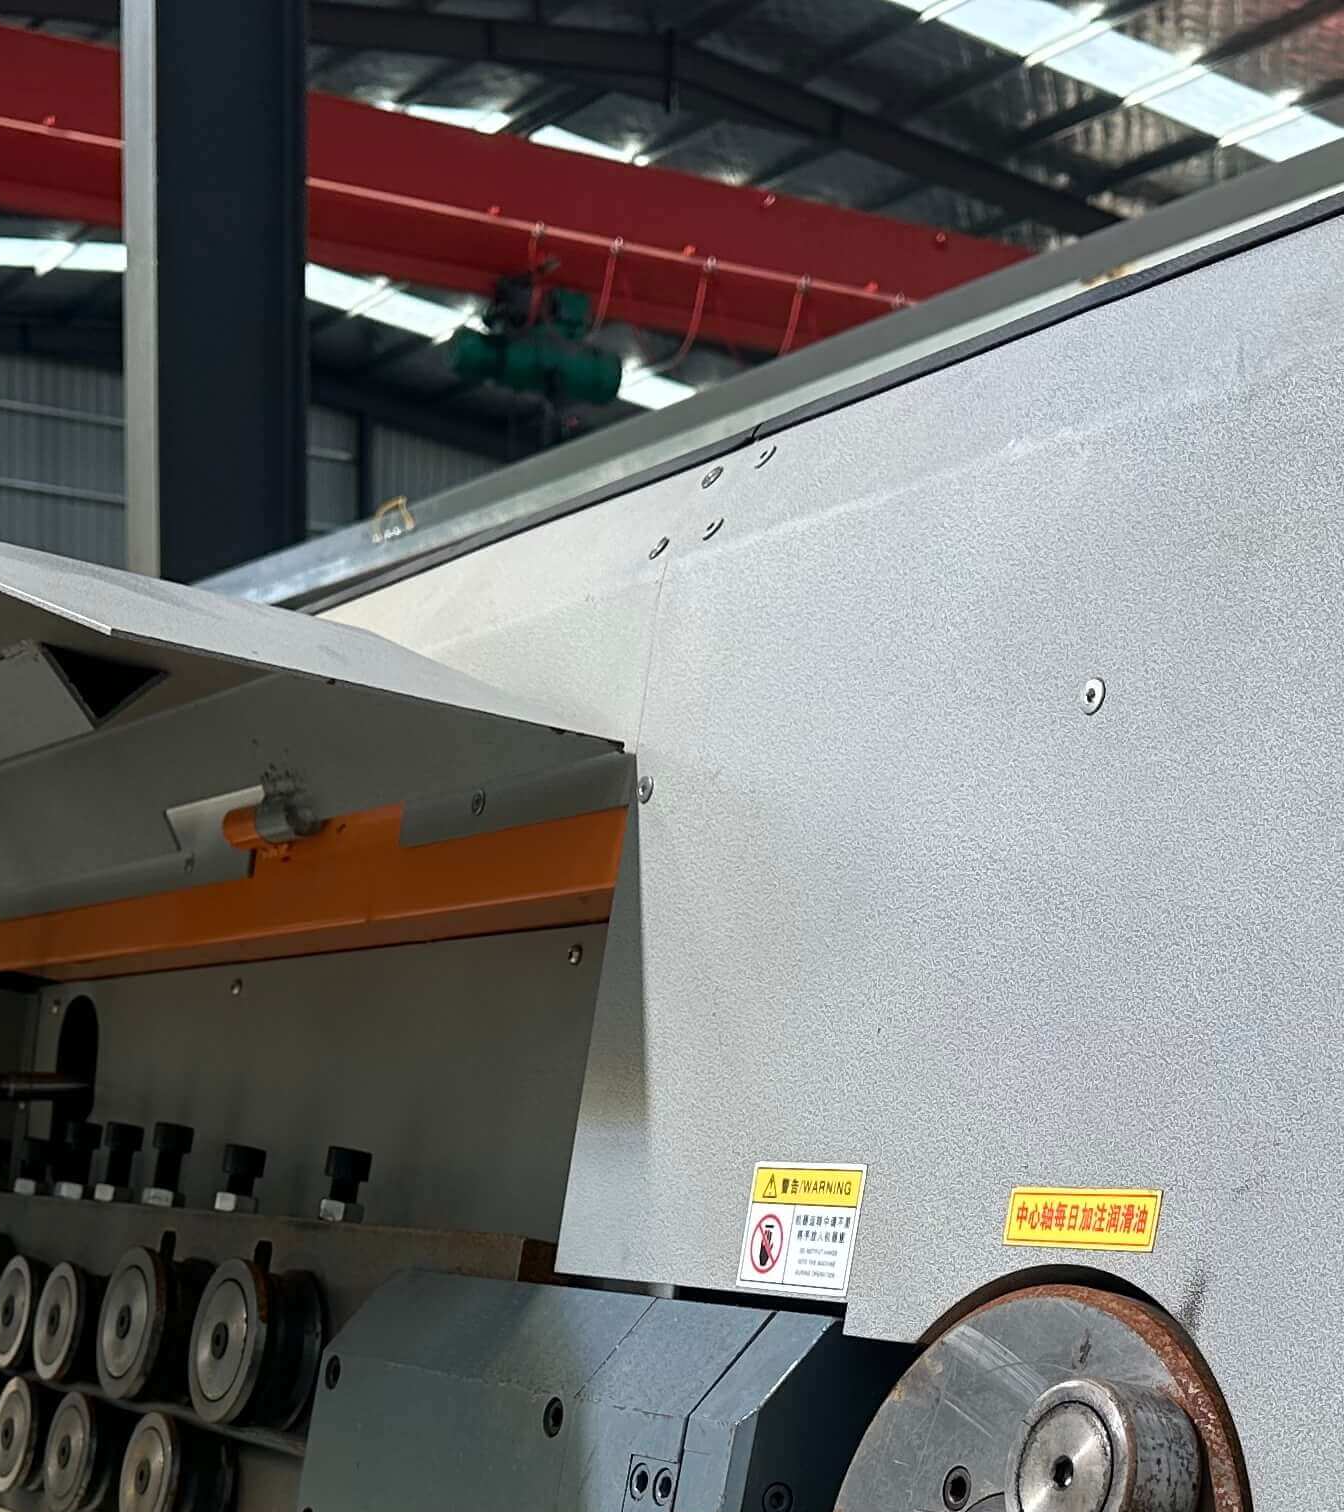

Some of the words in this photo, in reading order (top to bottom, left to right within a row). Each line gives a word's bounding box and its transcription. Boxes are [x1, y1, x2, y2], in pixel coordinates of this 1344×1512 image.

[1016, 1200, 1149, 1234] 中心轴每日加注润滑油
